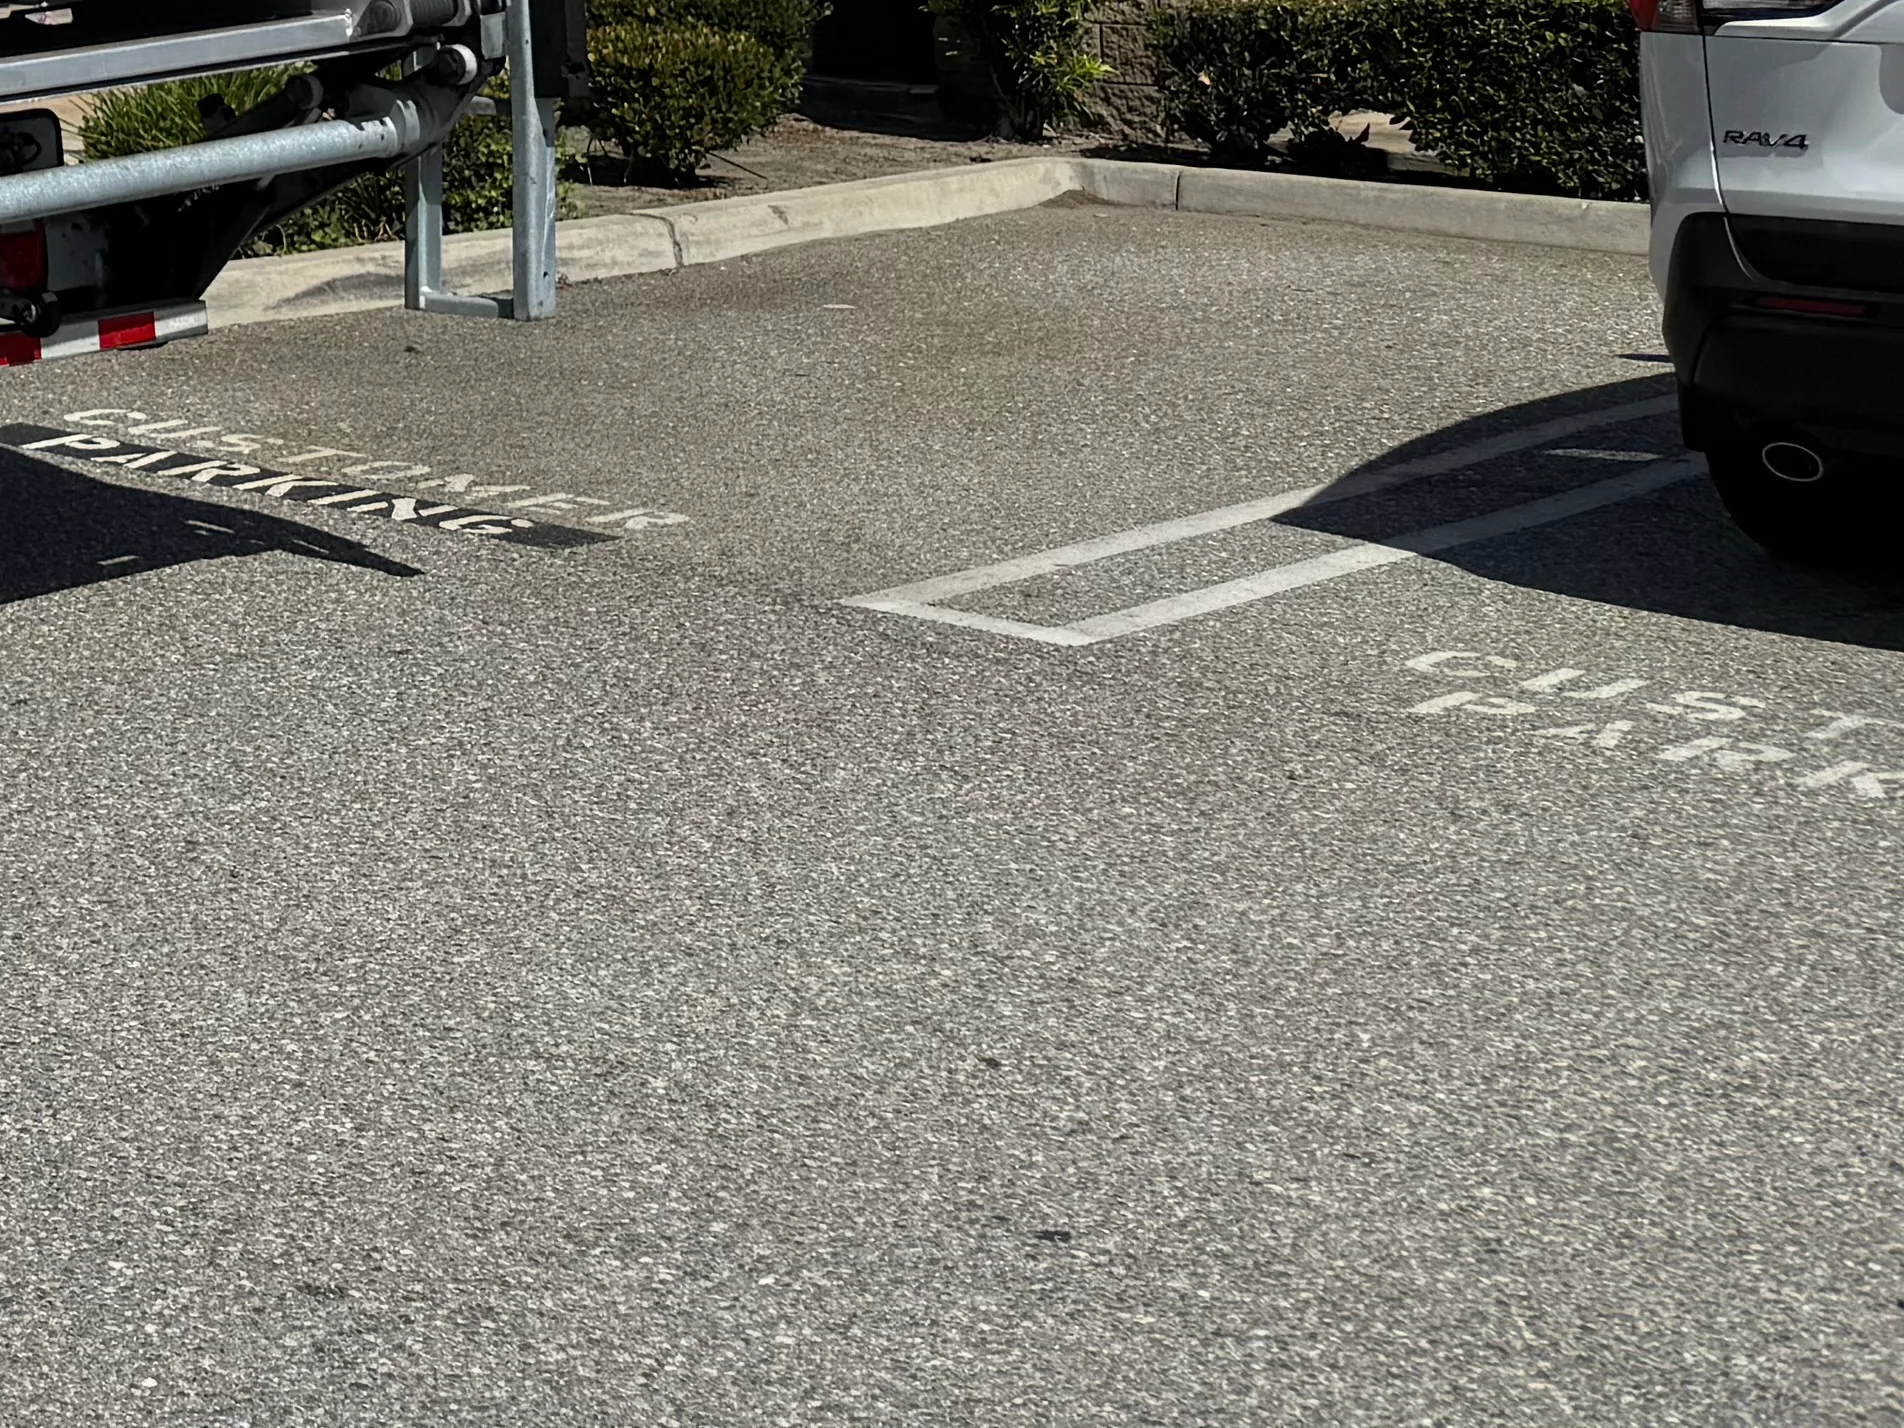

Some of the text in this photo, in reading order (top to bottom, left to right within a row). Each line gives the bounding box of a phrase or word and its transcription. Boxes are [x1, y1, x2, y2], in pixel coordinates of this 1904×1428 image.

[1722, 130, 1809, 150] RAV4
[24, 433, 534, 535] PARKING
[63, 408, 690, 531] CUSTOMER
